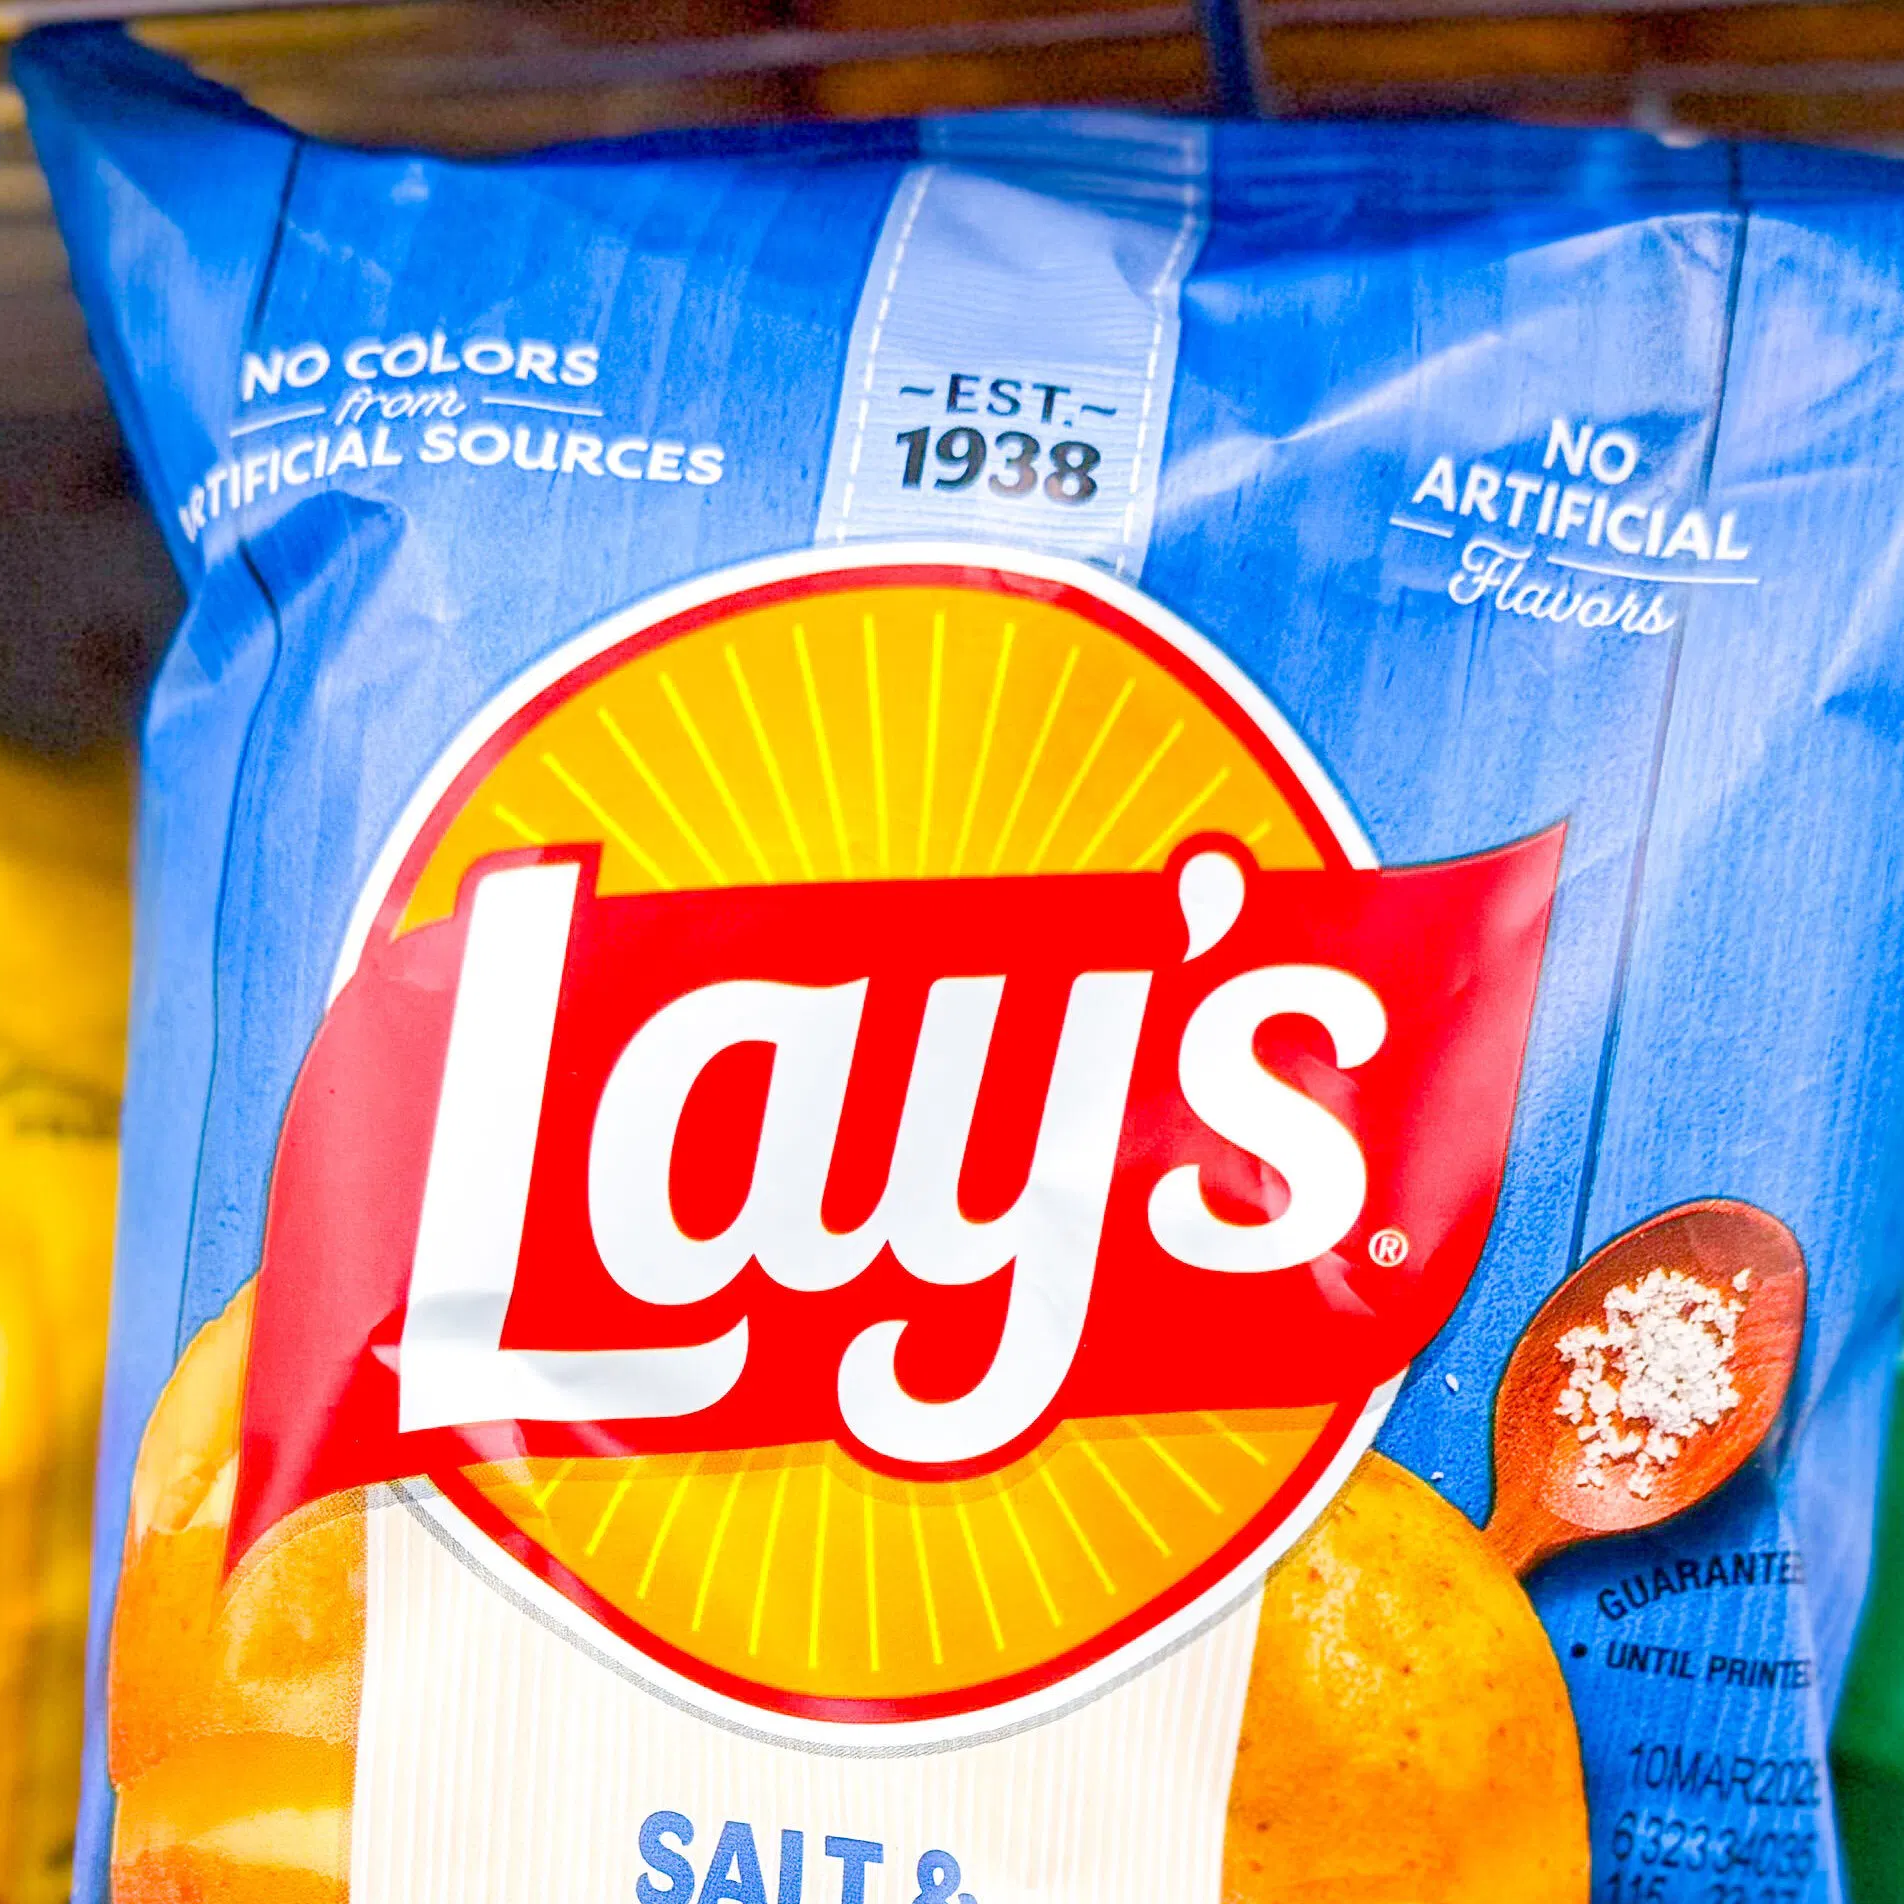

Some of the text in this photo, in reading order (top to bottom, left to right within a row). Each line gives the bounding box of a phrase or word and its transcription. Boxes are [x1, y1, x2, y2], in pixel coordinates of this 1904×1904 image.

[241, 331, 599, 402] NO COLORS
[335, 384, 467, 426] from
[419, 422, 725, 485] SOURCES
[895, 425, 1102, 507] 1938
[1543, 417, 1637, 485] NO
[1411, 455, 1750, 561] ARTIFICIAL
[1449, 538, 1677, 635] Flavors
[398, 850, 1388, 1463] Lay's
[1606, 1641, 1694, 1679] UNTIL
